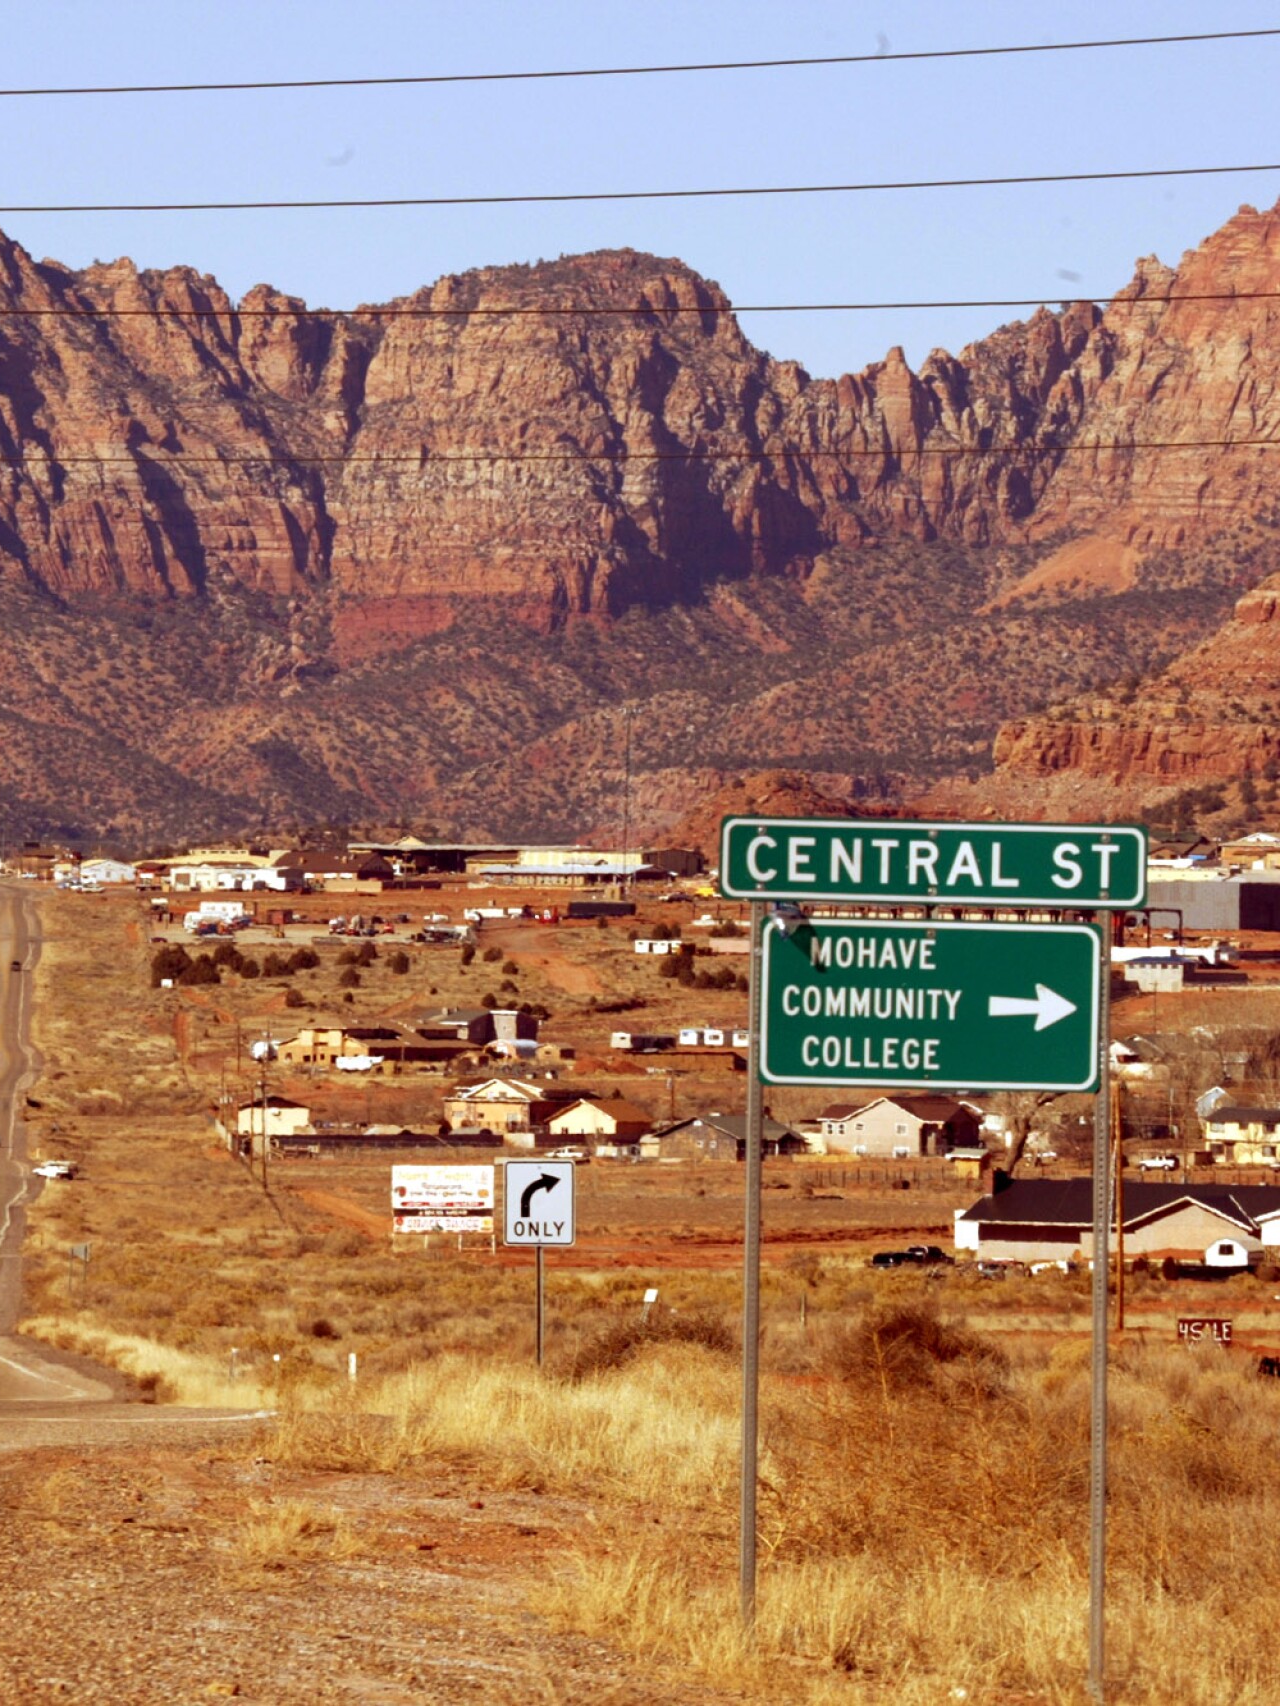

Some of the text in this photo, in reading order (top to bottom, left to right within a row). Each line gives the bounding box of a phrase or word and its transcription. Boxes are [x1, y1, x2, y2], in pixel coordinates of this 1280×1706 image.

[746, 836, 1120, 889] CENTRAL ST
[811, 936, 936, 970] MOHAVE
[782, 985, 961, 1020] COMMUNITY
[802, 1036, 940, 1070] COLLEGE
[514, 1221, 564, 1237] ONLY
[1179, 1322, 1231, 1341] 4SLE
